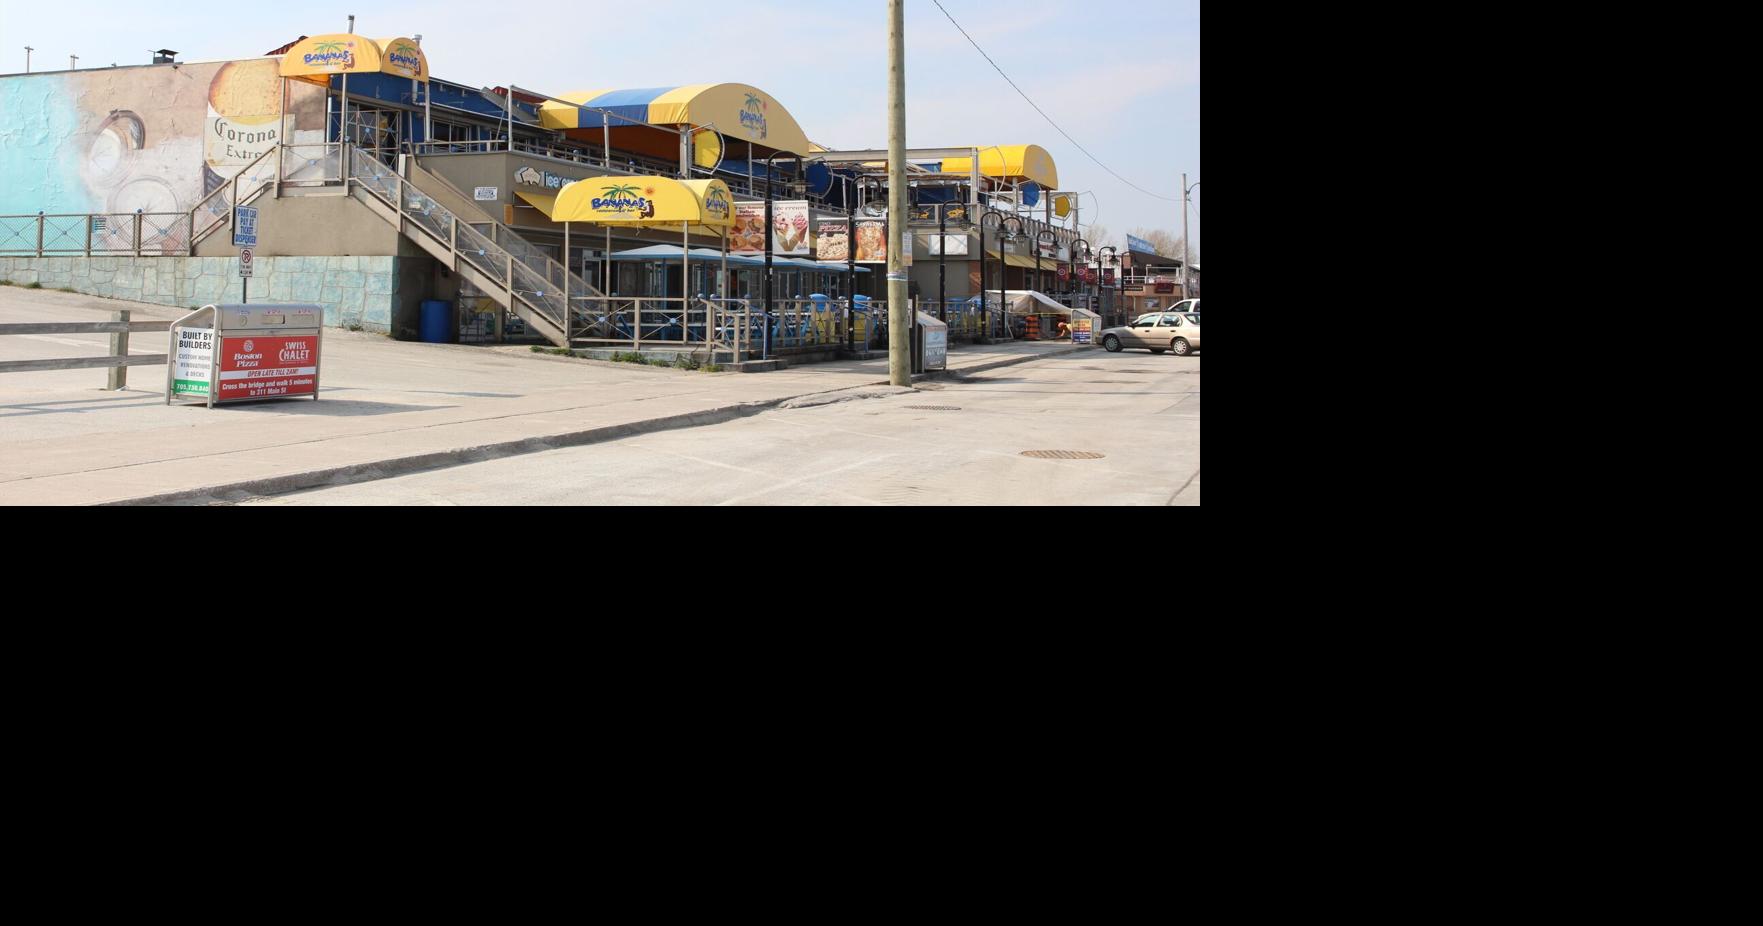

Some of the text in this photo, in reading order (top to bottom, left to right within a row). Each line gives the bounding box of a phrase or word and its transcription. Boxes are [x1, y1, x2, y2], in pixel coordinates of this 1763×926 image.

[303, 50, 350, 64] BANANAS
[389, 53, 418, 67] BANANAS
[214, 118, 277, 143] Corona
[591, 198, 645, 210] BANANAS
[182, 331, 213, 341] BUILT BY
[179, 340, 212, 350] BUILDERS
[285, 342, 306, 350] SWISS
[248, 370, 261, 378] OPEN
